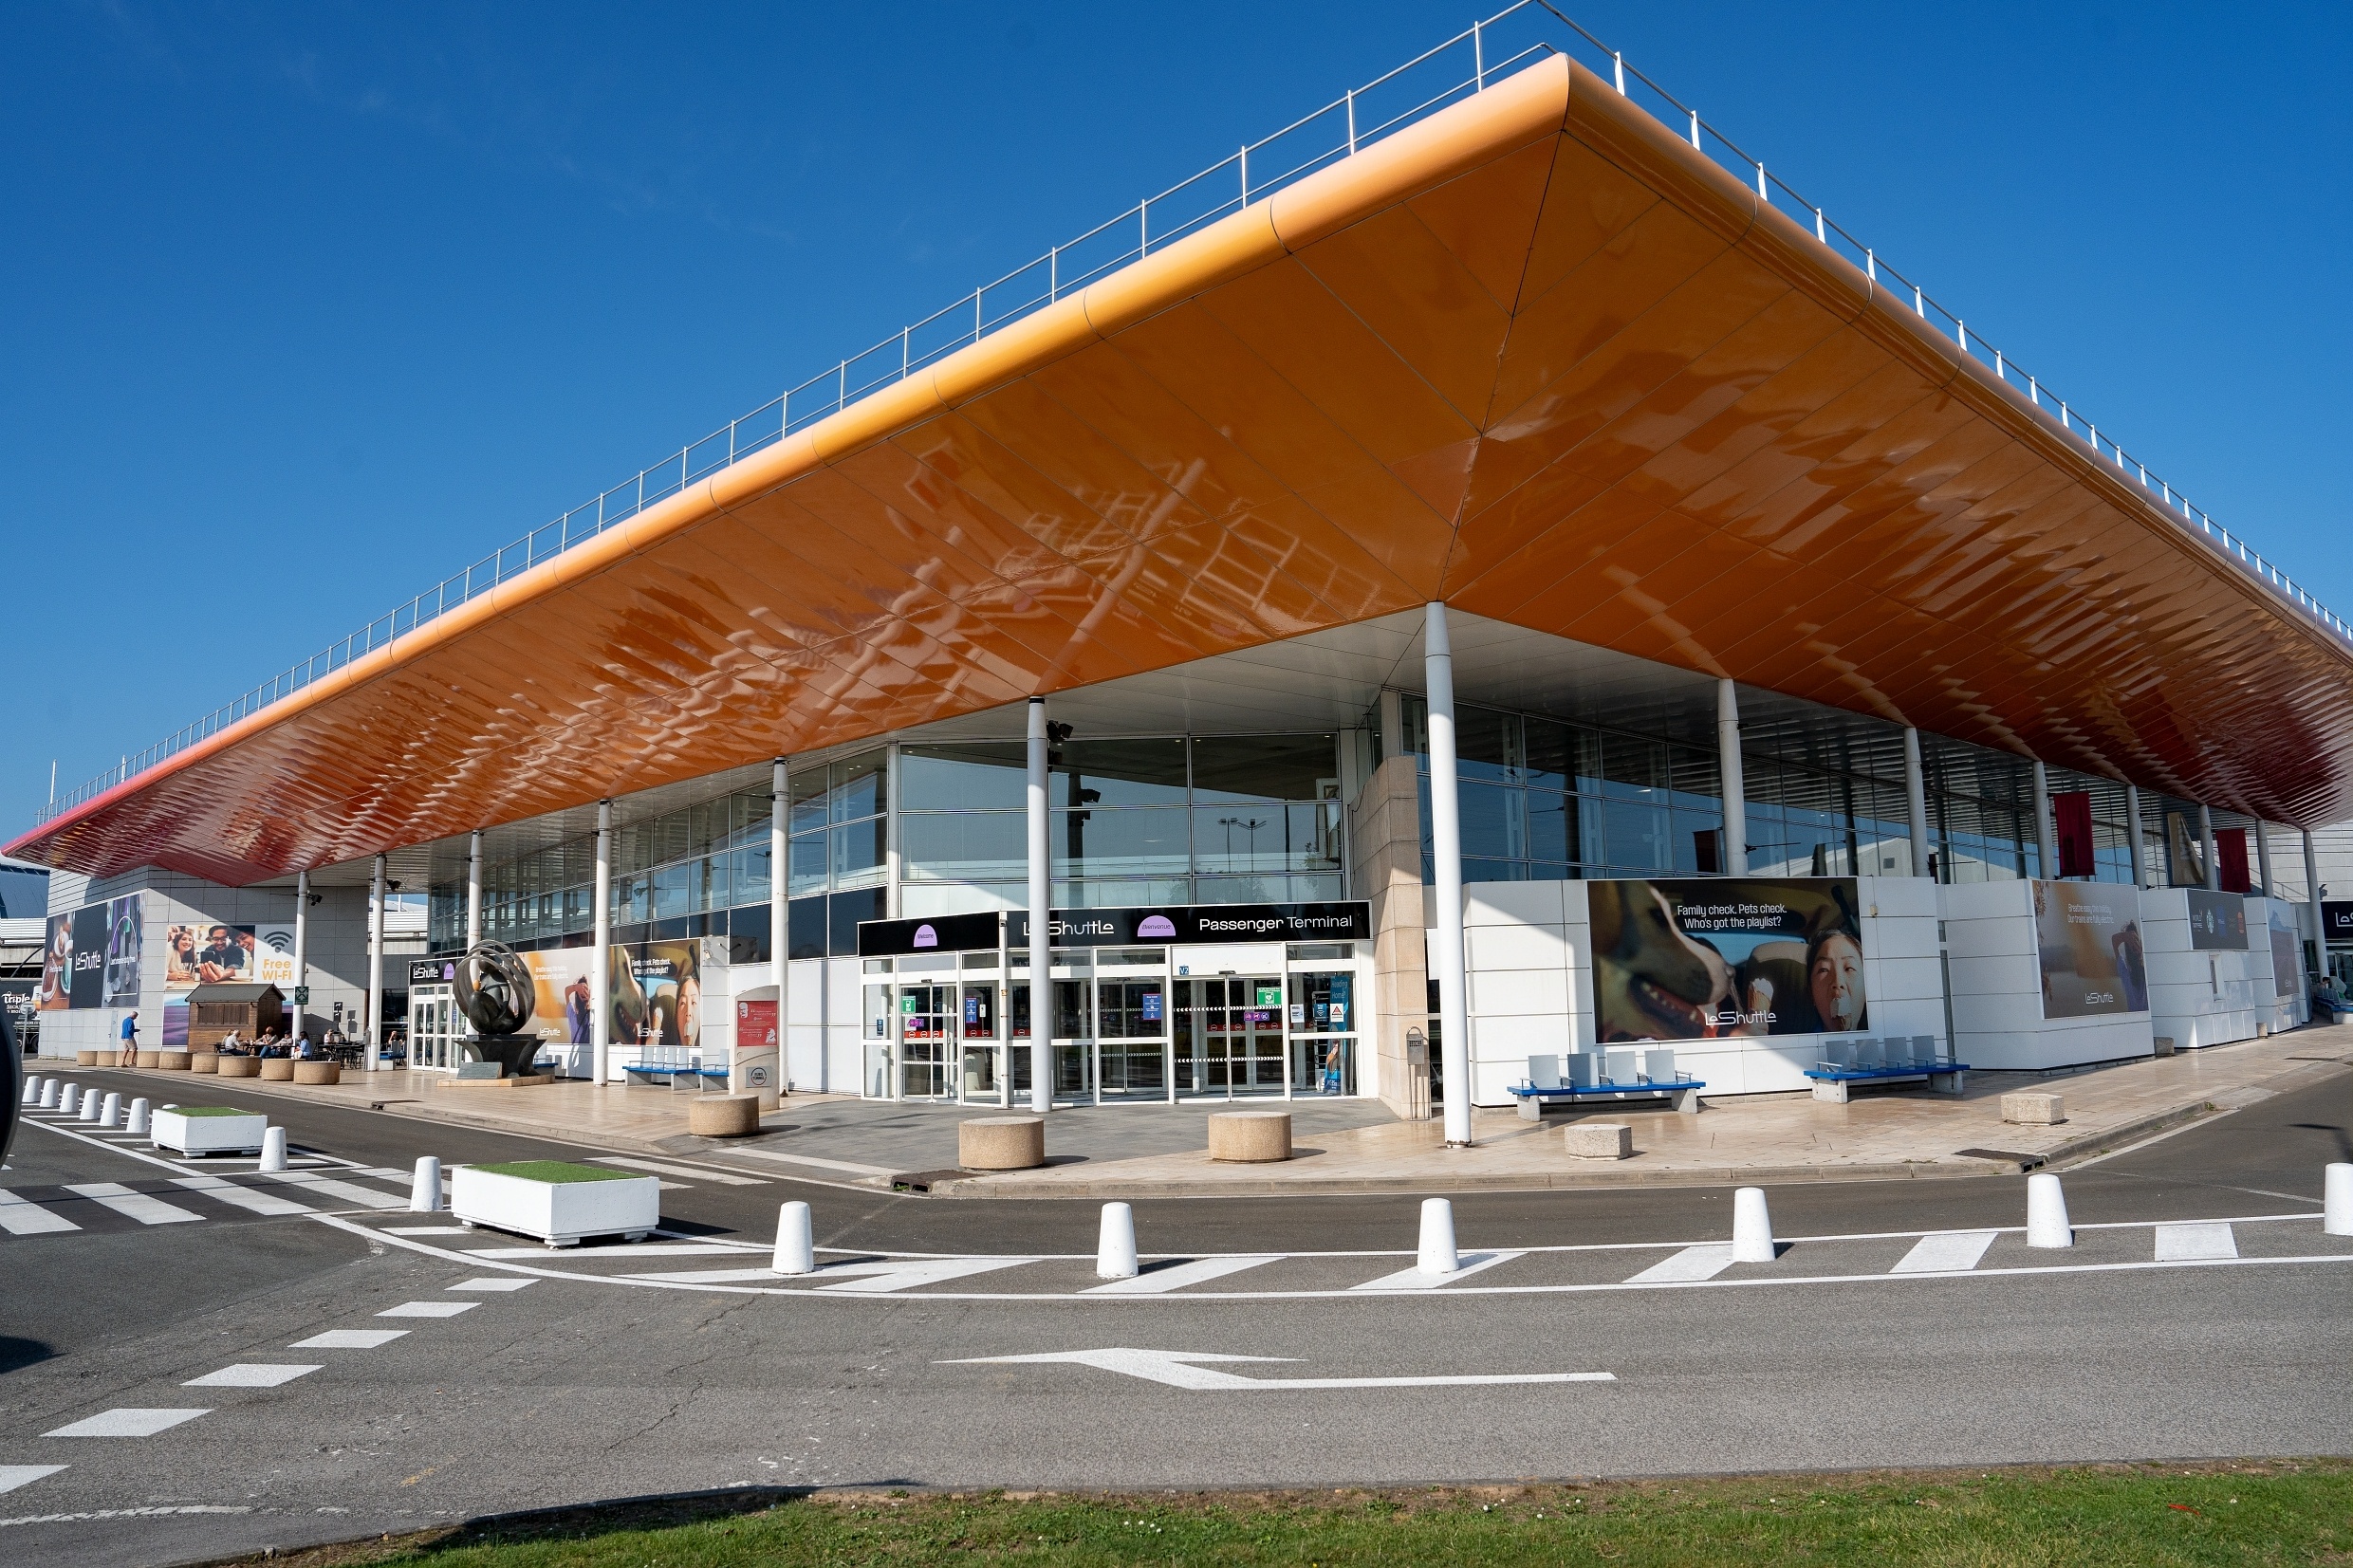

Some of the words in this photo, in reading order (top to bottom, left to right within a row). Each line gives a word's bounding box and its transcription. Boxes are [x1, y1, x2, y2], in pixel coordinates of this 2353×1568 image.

[1677, 904, 1707, 917] Family
[1708, 904, 1737, 915] check.
[1738, 903, 1758, 914] Pets
[1759, 903, 1788, 913] check.
[1199, 917, 1285, 932] Passenger
[1287, 914, 1352, 929] Terminal
[1684, 917, 1712, 929] Who's
[1713, 917, 1729, 931] got
[1730, 916, 1746, 928] the
[1747, 915, 1782, 930] playlist?
[75, 950, 102, 971] LeShuttle
[263, 958, 291, 968] Free
[262, 969, 292, 981] WI-FI
[413, 966, 439, 979] LeShuttle
[1179, 966, 1189, 975] V2
[2085, 992, 2114, 1005] LeShuttle
[1704, 1009, 1777, 1026] LeShuttle
[539, 1027, 561, 1037] LeShuttle
[637, 1027, 663, 1038] LeShuttle
